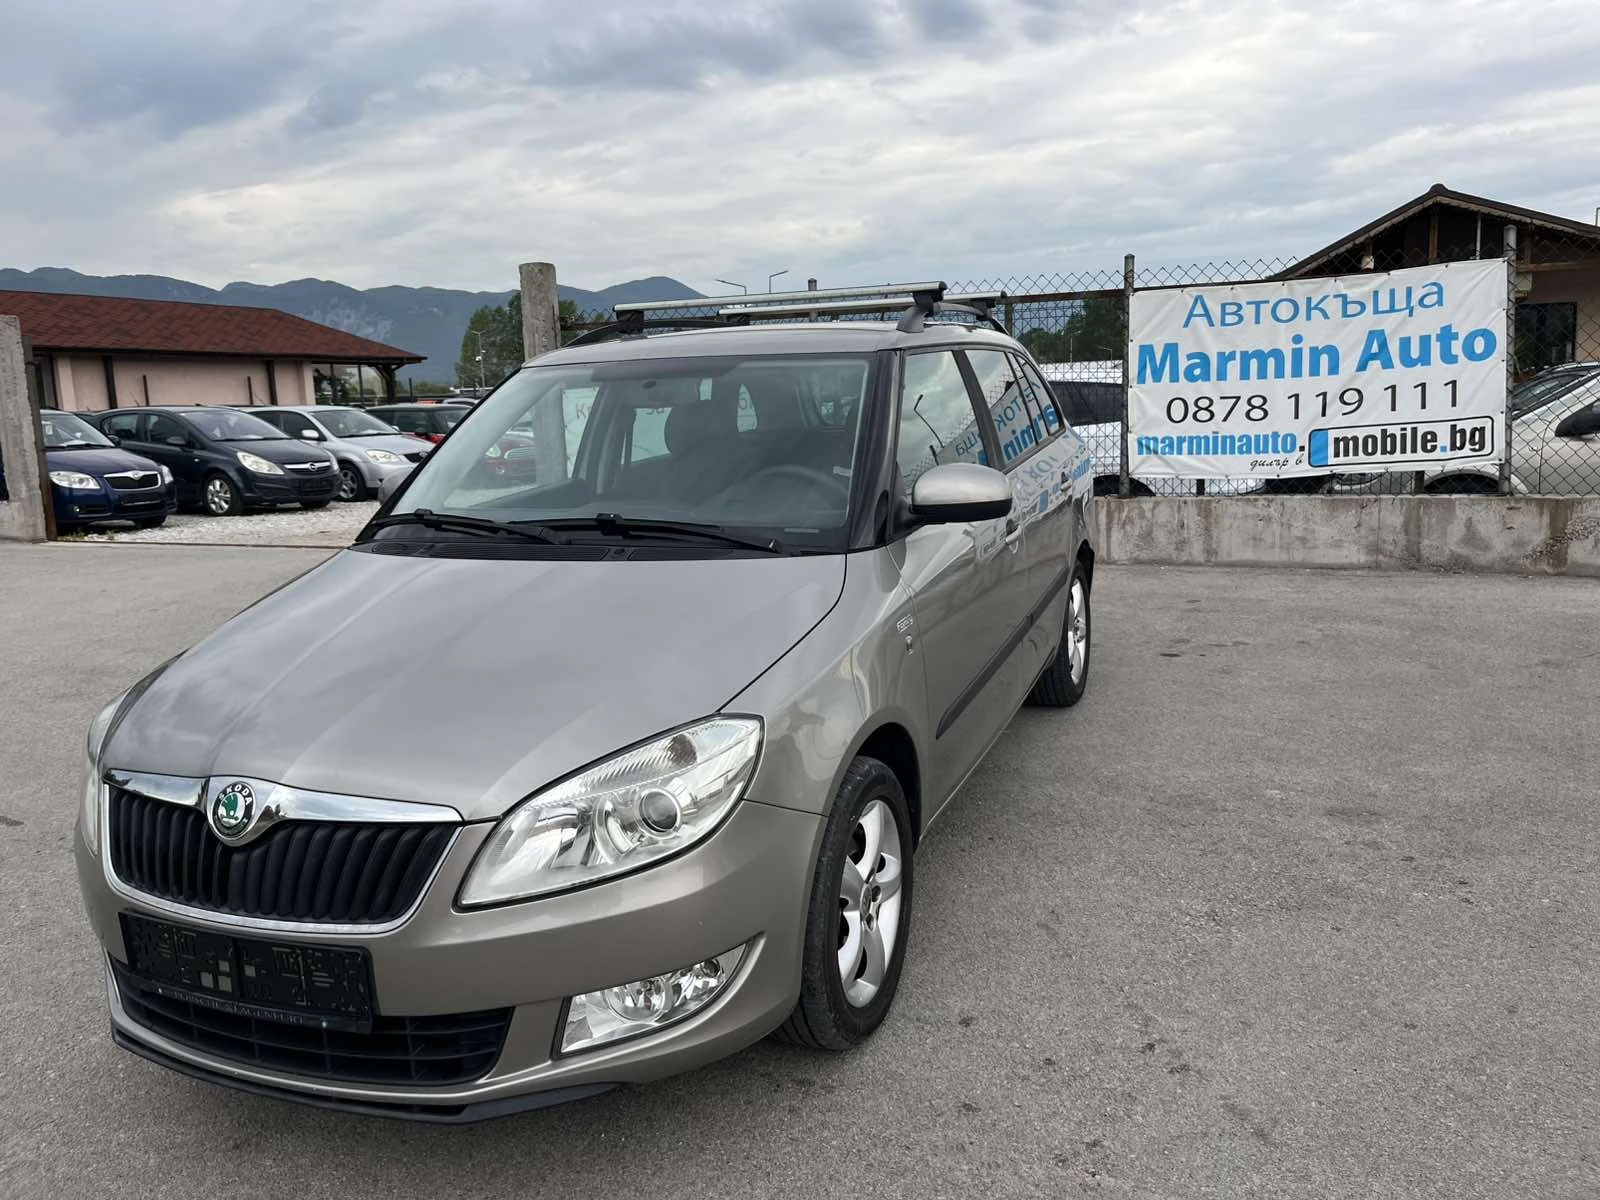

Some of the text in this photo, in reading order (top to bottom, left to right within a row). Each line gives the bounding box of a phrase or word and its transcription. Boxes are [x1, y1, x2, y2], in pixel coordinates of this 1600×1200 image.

[1183, 281, 1444, 328] Автокъща
[1136, 324, 1497, 384] Marmin Auto
[1166, 379, 1458, 423] 0878 119 111
[1333, 424, 1486, 458] mobile.bg
